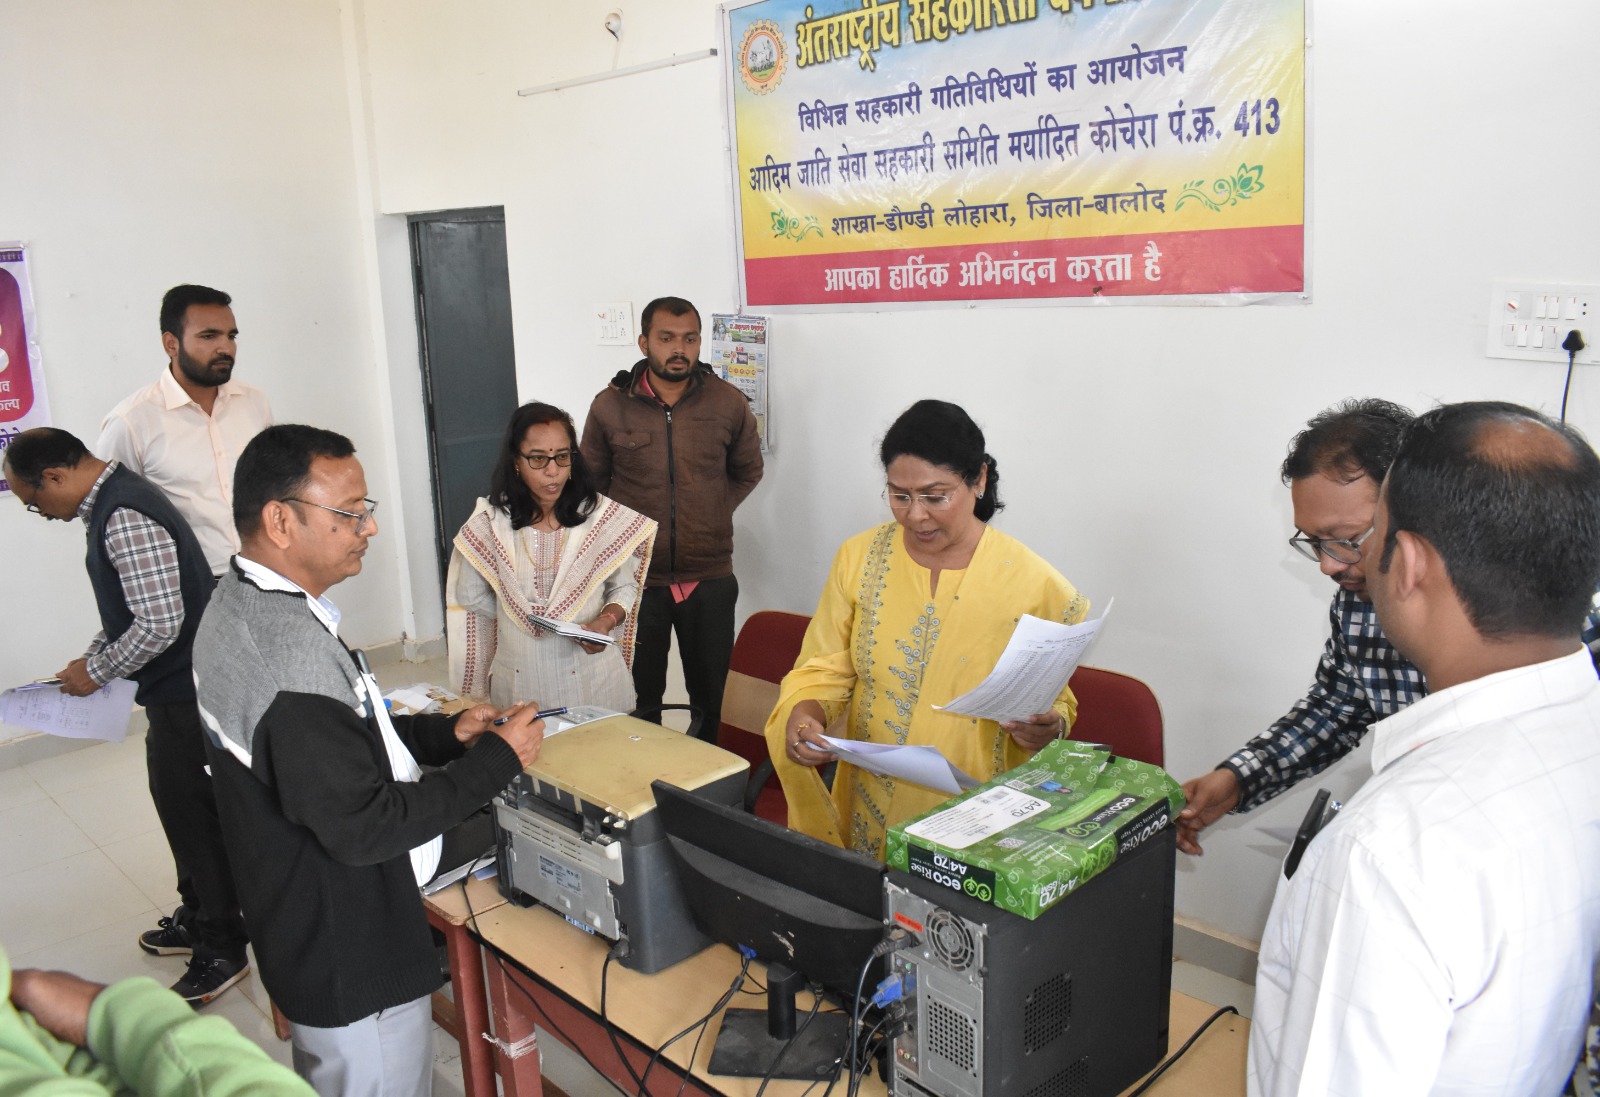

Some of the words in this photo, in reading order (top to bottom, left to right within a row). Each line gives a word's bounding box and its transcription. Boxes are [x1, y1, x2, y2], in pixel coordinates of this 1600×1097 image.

[797, 0, 900, 71] अंतराष्ट्रीय
[798, 98, 848, 132] विभिन्न
[856, 81, 922, 124] सहकारी
[930, 61, 1037, 110] गतिविधियों
[1047, 64, 1077, 92] का
[1087, 43, 1187, 85] आयोजन
[749, 154, 791, 193] आदिम
[797, 147, 831, 187] जाति
[838, 143, 867, 182] सेवा
[874, 131, 935, 181] सहकारी
[943, 123, 1000, 170] समिति
[1008, 114, 1080, 162] मर्यादित
[1089, 103, 1158, 152] कोचेरा
[1234, 97, 1281, 137] 413
[943, 199, 1016, 228] लोहारा,
[1027, 182, 1167, 221] जिला-बालोद
[824, 266, 880, 292] आपका
[889, 255, 949, 290] हार्दिक
[959, 250, 1056, 287] अभिनंदन
[1066, 253, 1132, 283] करता
[1143, 240, 1162, 282] है
